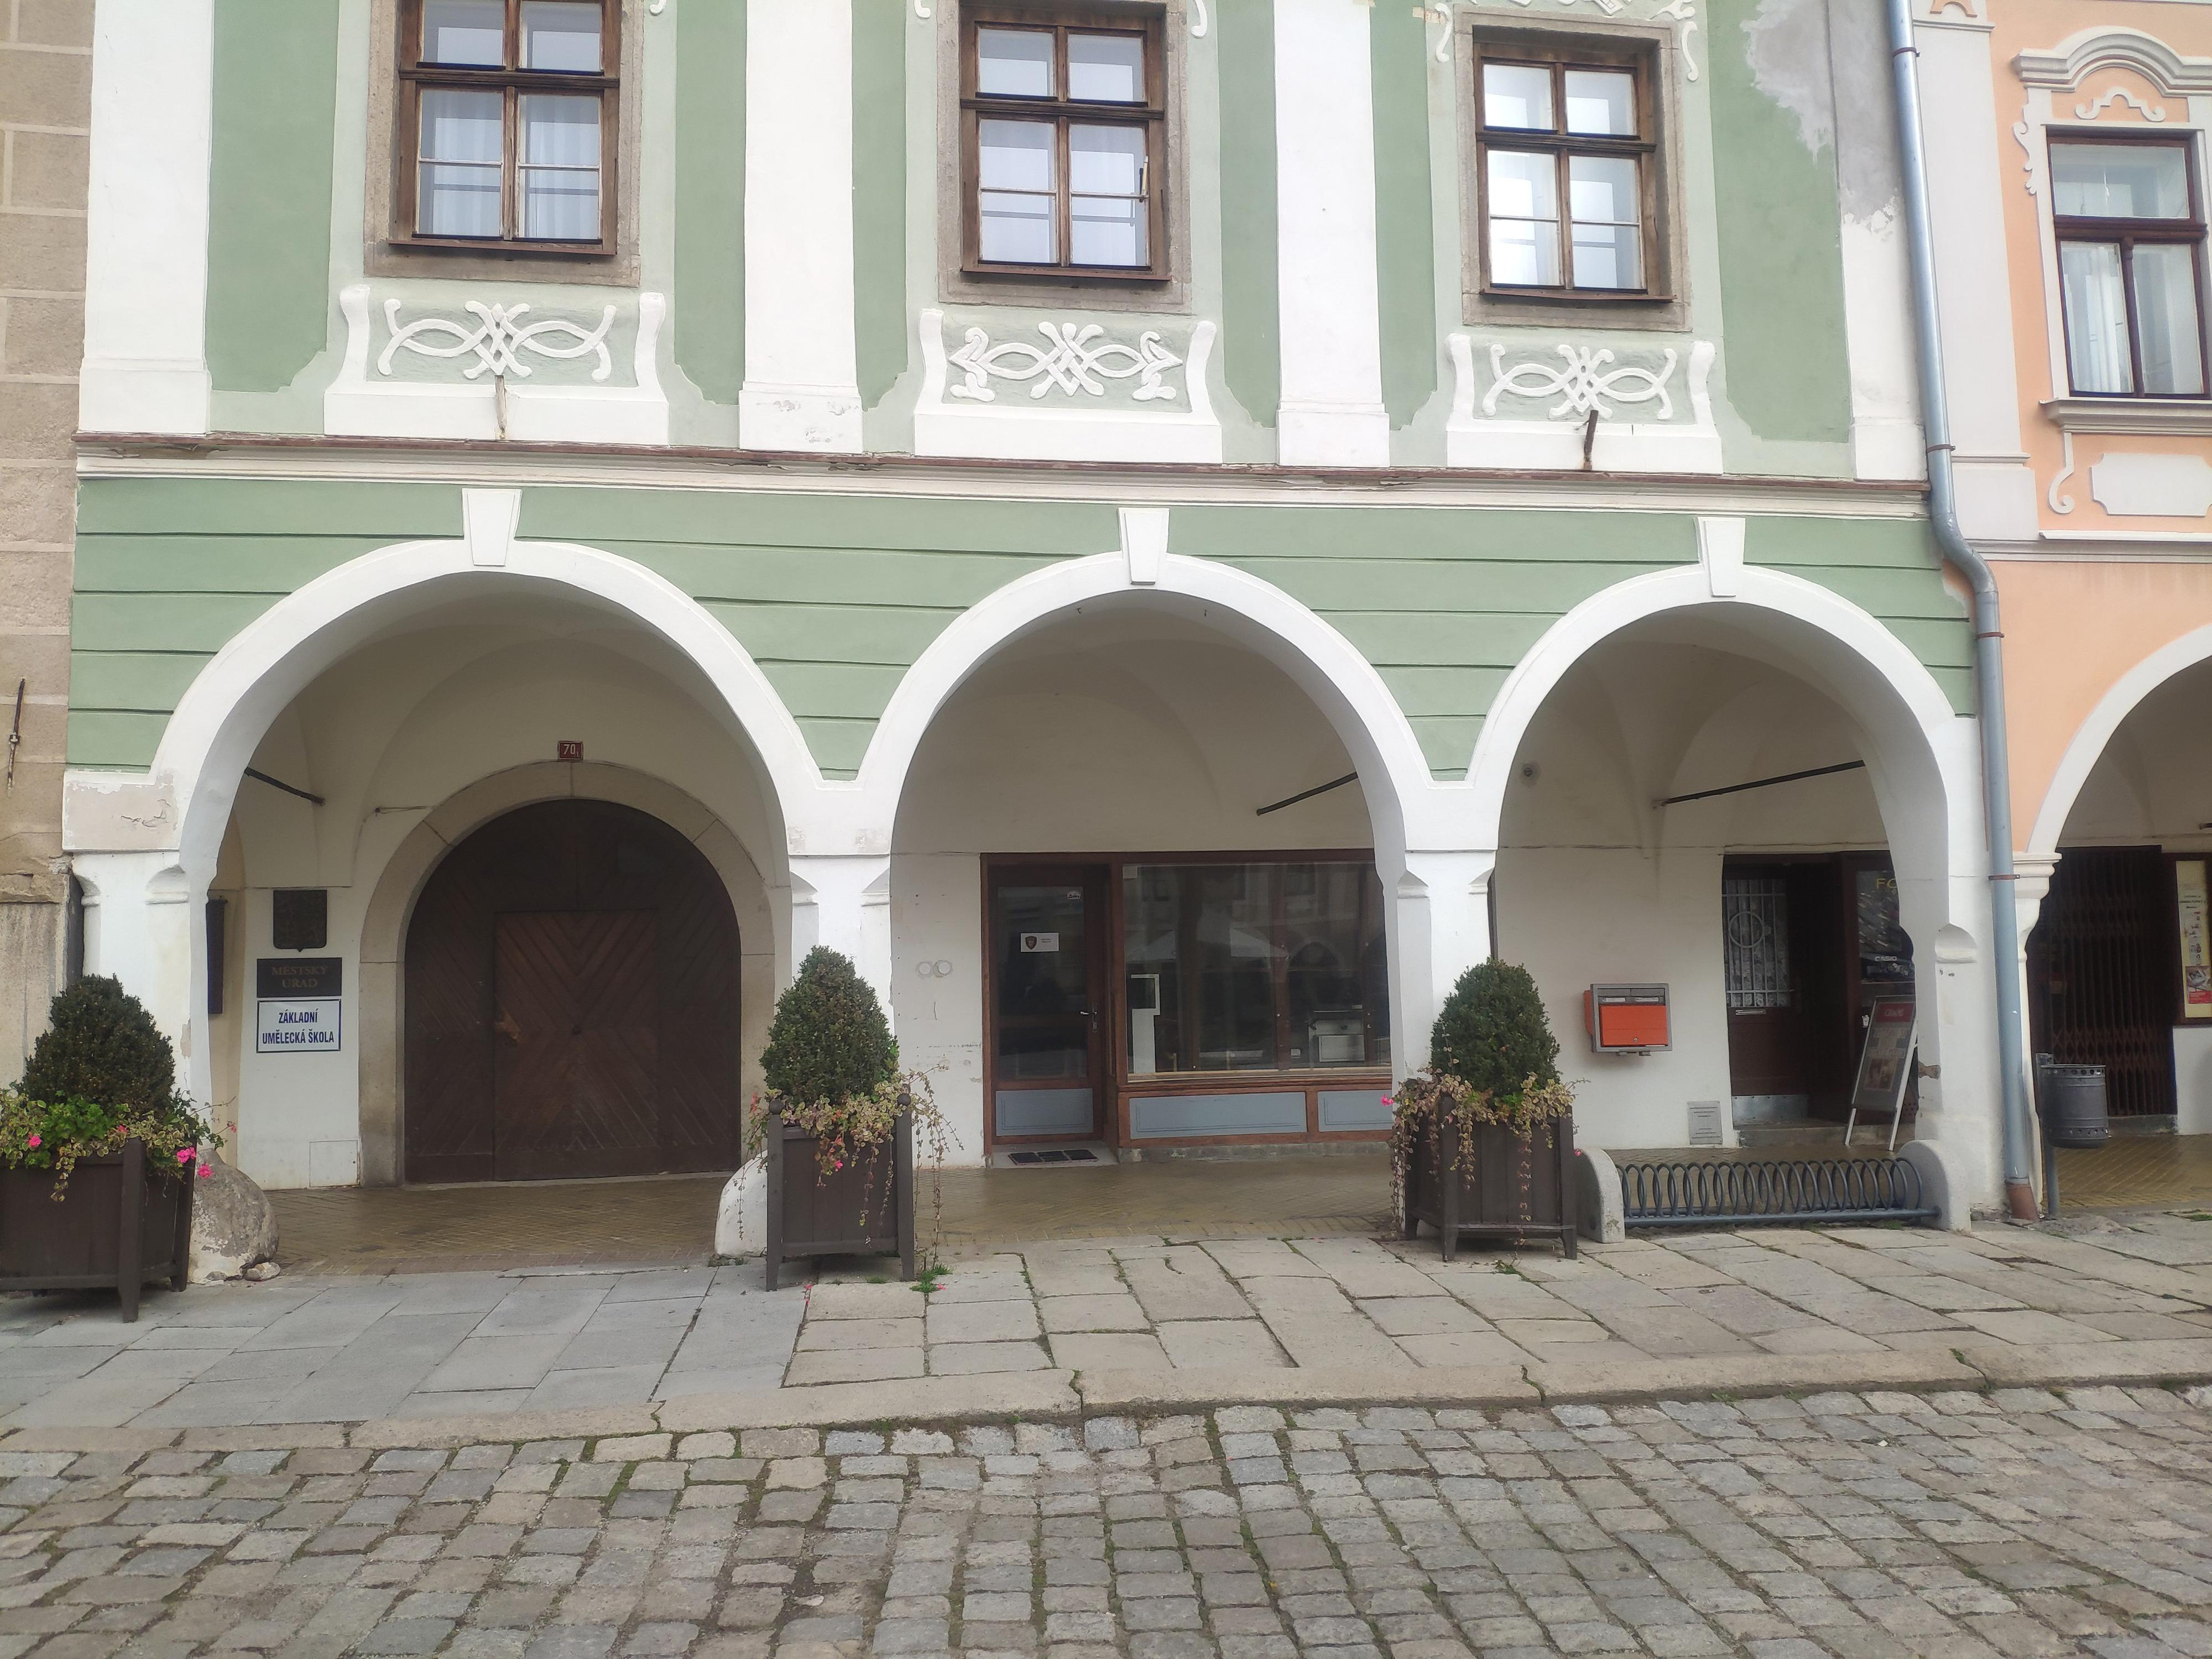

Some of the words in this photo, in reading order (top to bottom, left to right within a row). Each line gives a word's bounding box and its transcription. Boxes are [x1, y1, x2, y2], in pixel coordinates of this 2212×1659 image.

[564, 744, 576, 754] 70
[278, 1008, 319, 1024] ZÁKLADNÍ
[262, 1029, 306, 1045] UMĚLECKÁ
[308, 1029, 334, 1043] ŠKOLA
